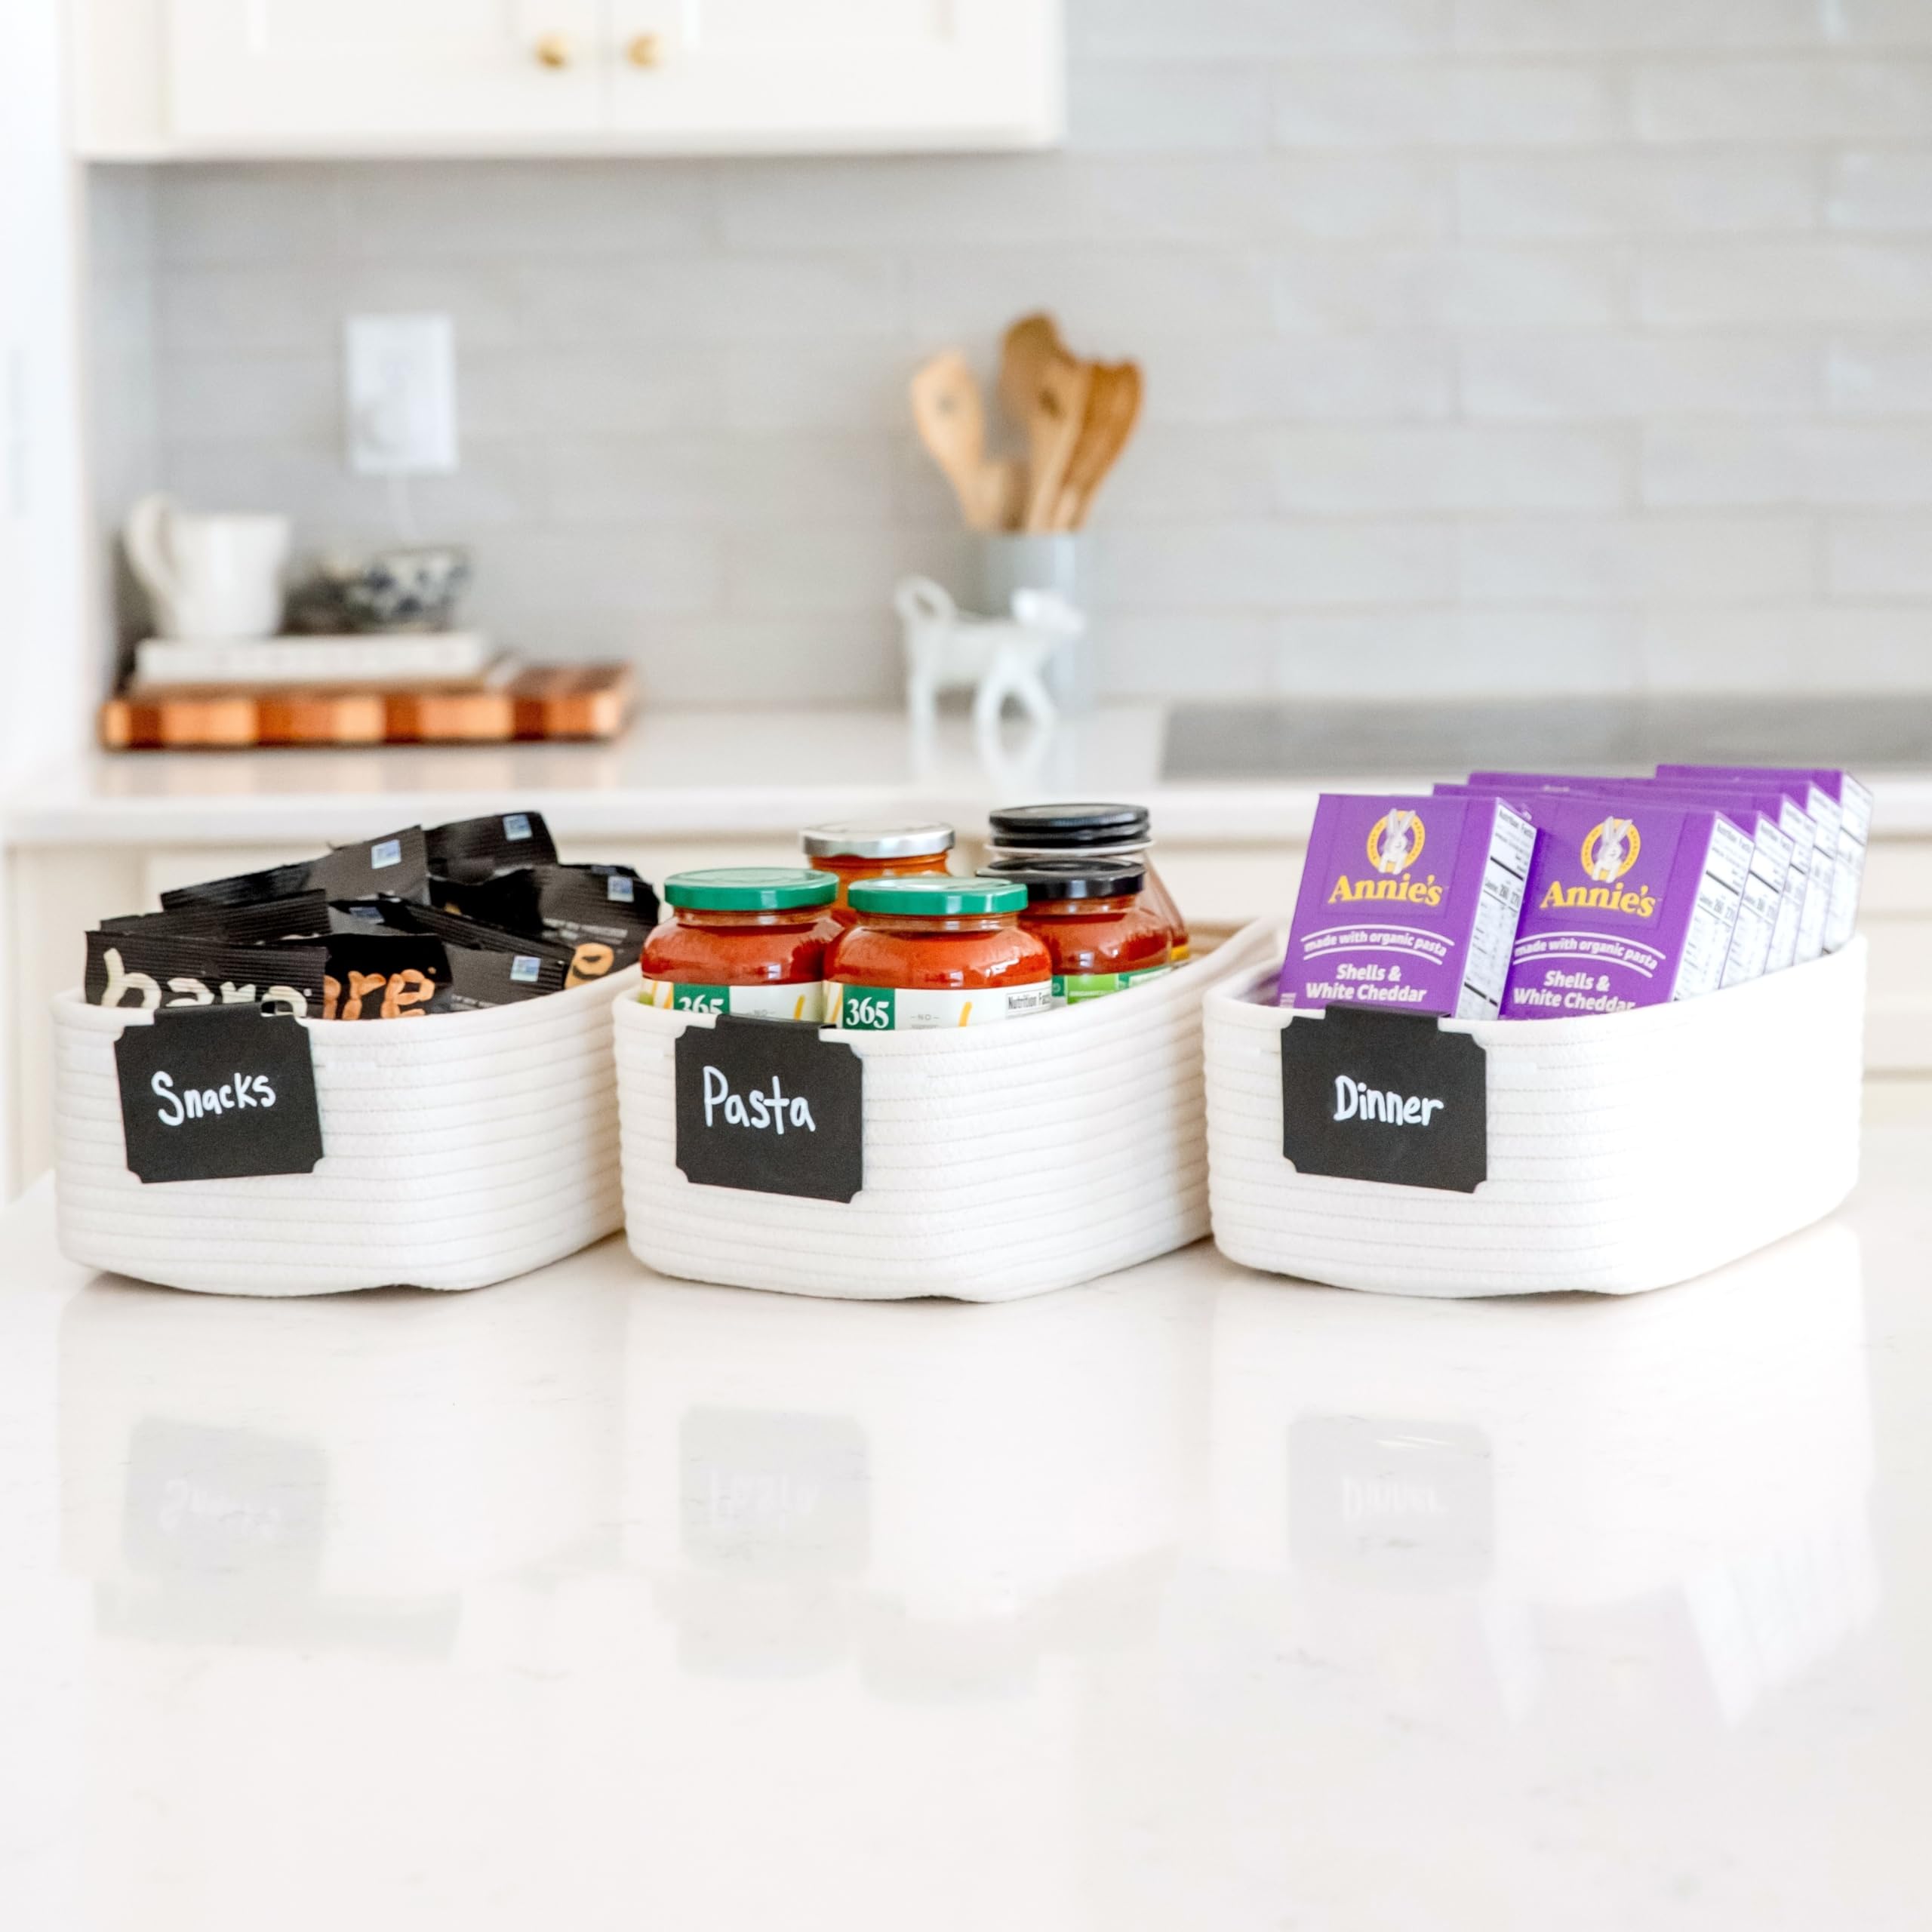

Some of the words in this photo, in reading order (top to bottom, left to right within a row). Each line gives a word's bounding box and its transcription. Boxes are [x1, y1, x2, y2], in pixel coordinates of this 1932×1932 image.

[1327, 873, 1442, 906] Annie's
[1540, 881, 1656, 918] Annie's
[1304, 935, 1337, 952] made
[1339, 931, 1367, 944] with
[1369, 932, 1414, 947] organic
[1413, 938, 1447, 957] pasta
[1514, 940, 1546, 957] made
[1549, 938, 1578, 951] with
[1579, 940, 1625, 956] organic
[1624, 949, 1658, 970] pasta
[1336, 964, 1386, 981] Shells
[1388, 965, 1401, 982] &
[1543, 971, 1594, 990] Shells
[1595, 975, 1610, 992] &
[678, 994, 724, 1014] 365
[1306, 983, 1354, 1000] White
[1357, 984, 1427, 1002] Cheddar
[1513, 988, 1561, 1008] White
[1564, 992, 1636, 1012] Cheddar
[846, 997, 889, 1029] 365
[151, 1071, 275, 1126] Snacks
[703, 1065, 817, 1135] Pasta
[1333, 1075, 1444, 1126] Dinner
